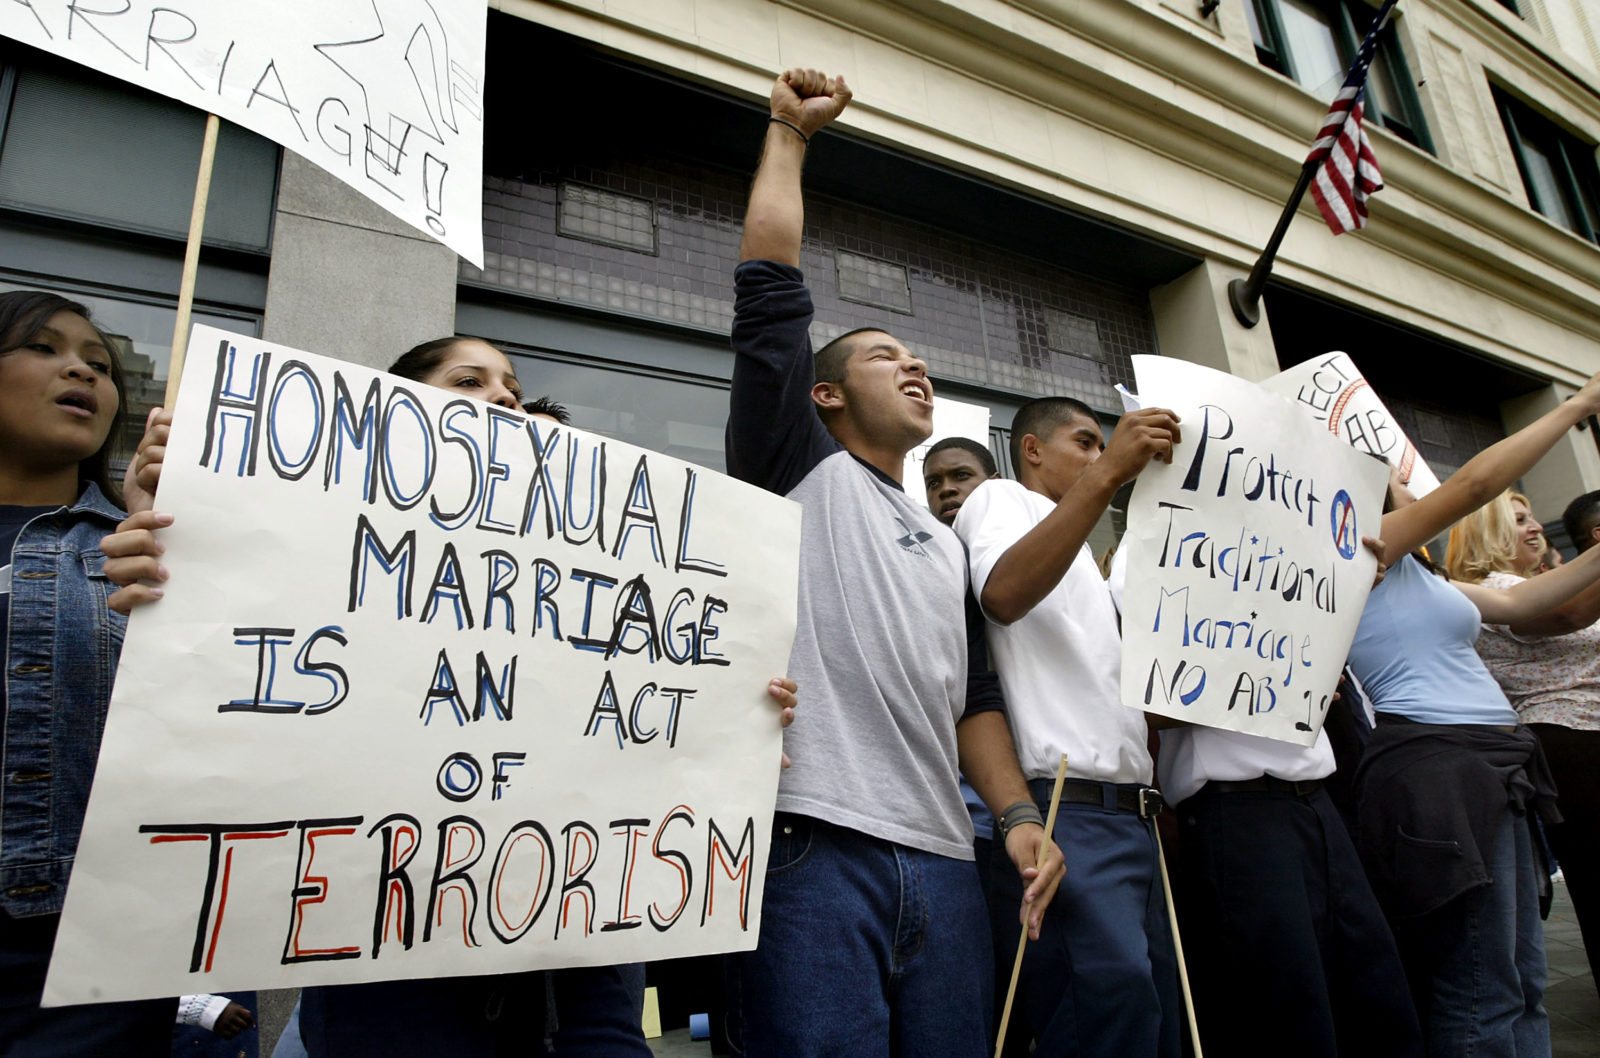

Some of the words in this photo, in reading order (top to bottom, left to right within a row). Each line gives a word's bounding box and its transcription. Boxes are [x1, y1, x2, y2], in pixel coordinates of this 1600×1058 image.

[1297, 355, 1350, 421] ECT
[199, 338, 728, 578] HOMOSEXUAL
[1180, 404, 1321, 527] Protect
[347, 513, 732, 667] MARRIAGE
[1158, 501, 1337, 614] Traditional
[218, 625, 350, 716] IS
[419, 647, 518, 727] AN
[584, 670, 698, 750] ACT
[1144, 658, 1207, 706] NO
[1227, 671, 1277, 716] AB
[1152, 586, 1313, 688] Marriage
[436, 752, 527, 803] OF
[138, 805, 756, 974] TERRORISM
